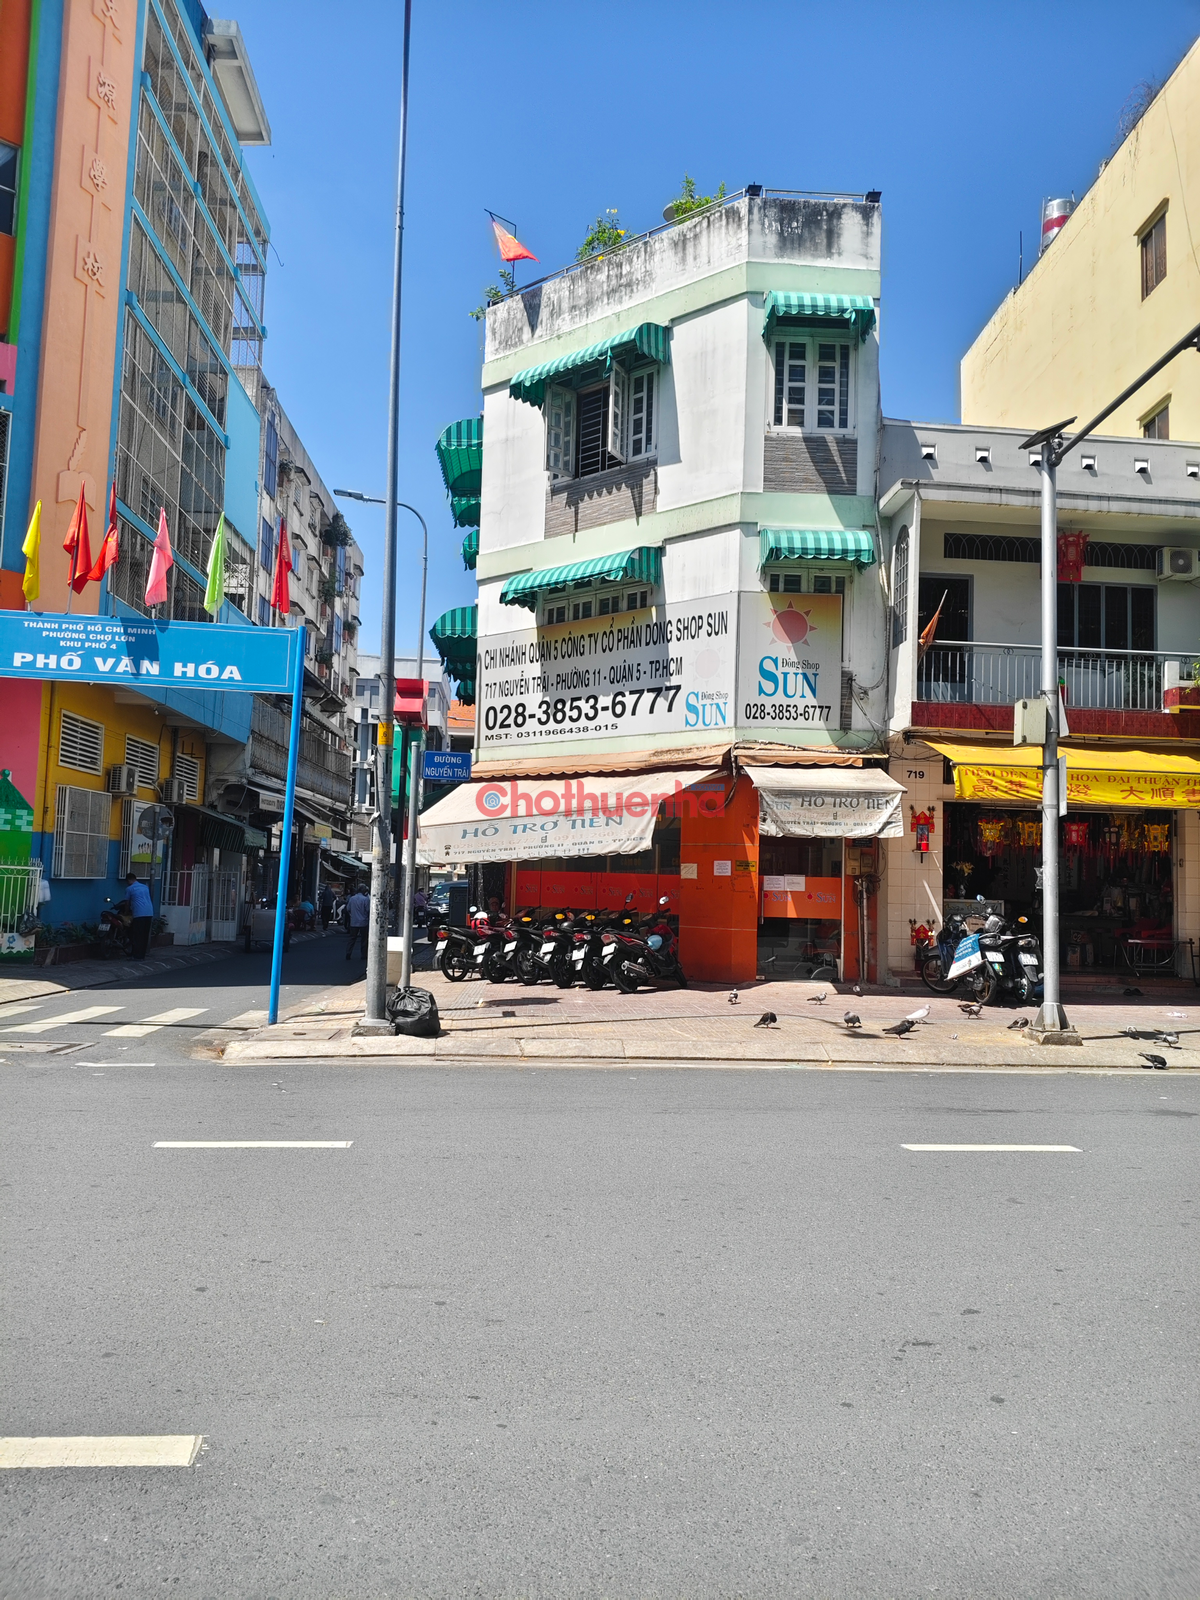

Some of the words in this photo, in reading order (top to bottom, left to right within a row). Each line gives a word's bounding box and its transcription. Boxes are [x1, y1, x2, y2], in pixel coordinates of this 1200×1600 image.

[23, 621, 59, 630] THÀNH
[62, 622, 85, 632] PHỐ
[105, 625, 124, 633] CHÍ
[127, 627, 156, 635] MINH
[42, 631, 86, 640] PHƯỜNG
[89, 634, 112, 642] CHỢ
[60, 640, 81, 648] KHU
[84, 641, 107, 649] PHỐ
[484, 648, 498, 670] CHI
[499, 640, 527, 668] NHÁNH
[528, 635, 552, 667] QUẬN
[553, 639, 559, 661] 5
[560, 631, 586, 660] CÔNG
[588, 632, 600, 655] TY
[601, 617, 615, 653] CỔ
[675, 614, 704, 642] SHOP
[706, 610, 728, 637] SUN
[12, 651, 86, 671] PHỐ
[94, 655, 160, 677] VĂN
[173, 660, 243, 681] HÓA
[781, 657, 801, 671] Đông
[801, 659, 820, 672] Shop
[485, 682, 497, 699] 717
[499, 670, 530, 698] NGUYỄN
[532, 671, 550, 694] TRÃI
[556, 666, 590, 692] PHƯỜNG
[593, 668, 601, 686] 11
[609, 659, 634, 687] QUẬN
[635, 663, 641, 681] 5
[649, 656, 683, 679] TP.HCM
[758, 655, 819, 699] SUN
[715, 690, 729, 701] Shop
[485, 684, 682, 731] 028-3853-6777
[685, 691, 728, 727] SUN
[744, 703, 832, 722] 028-3853-6777
[484, 732, 513, 742] MST:
[516, 722, 619, 739] 0311966438-015
[434, 755, 462, 764] ĐƯỜNG
[425, 765, 453, 777] NGUYỄN
[454, 766, 469, 778] TRÃI
[906, 769, 925, 780] 719
[962, 767, 996, 778] TIỆM
[1070, 773, 1100, 783] HOA
[1135, 776, 1181, 787] THUẬN
